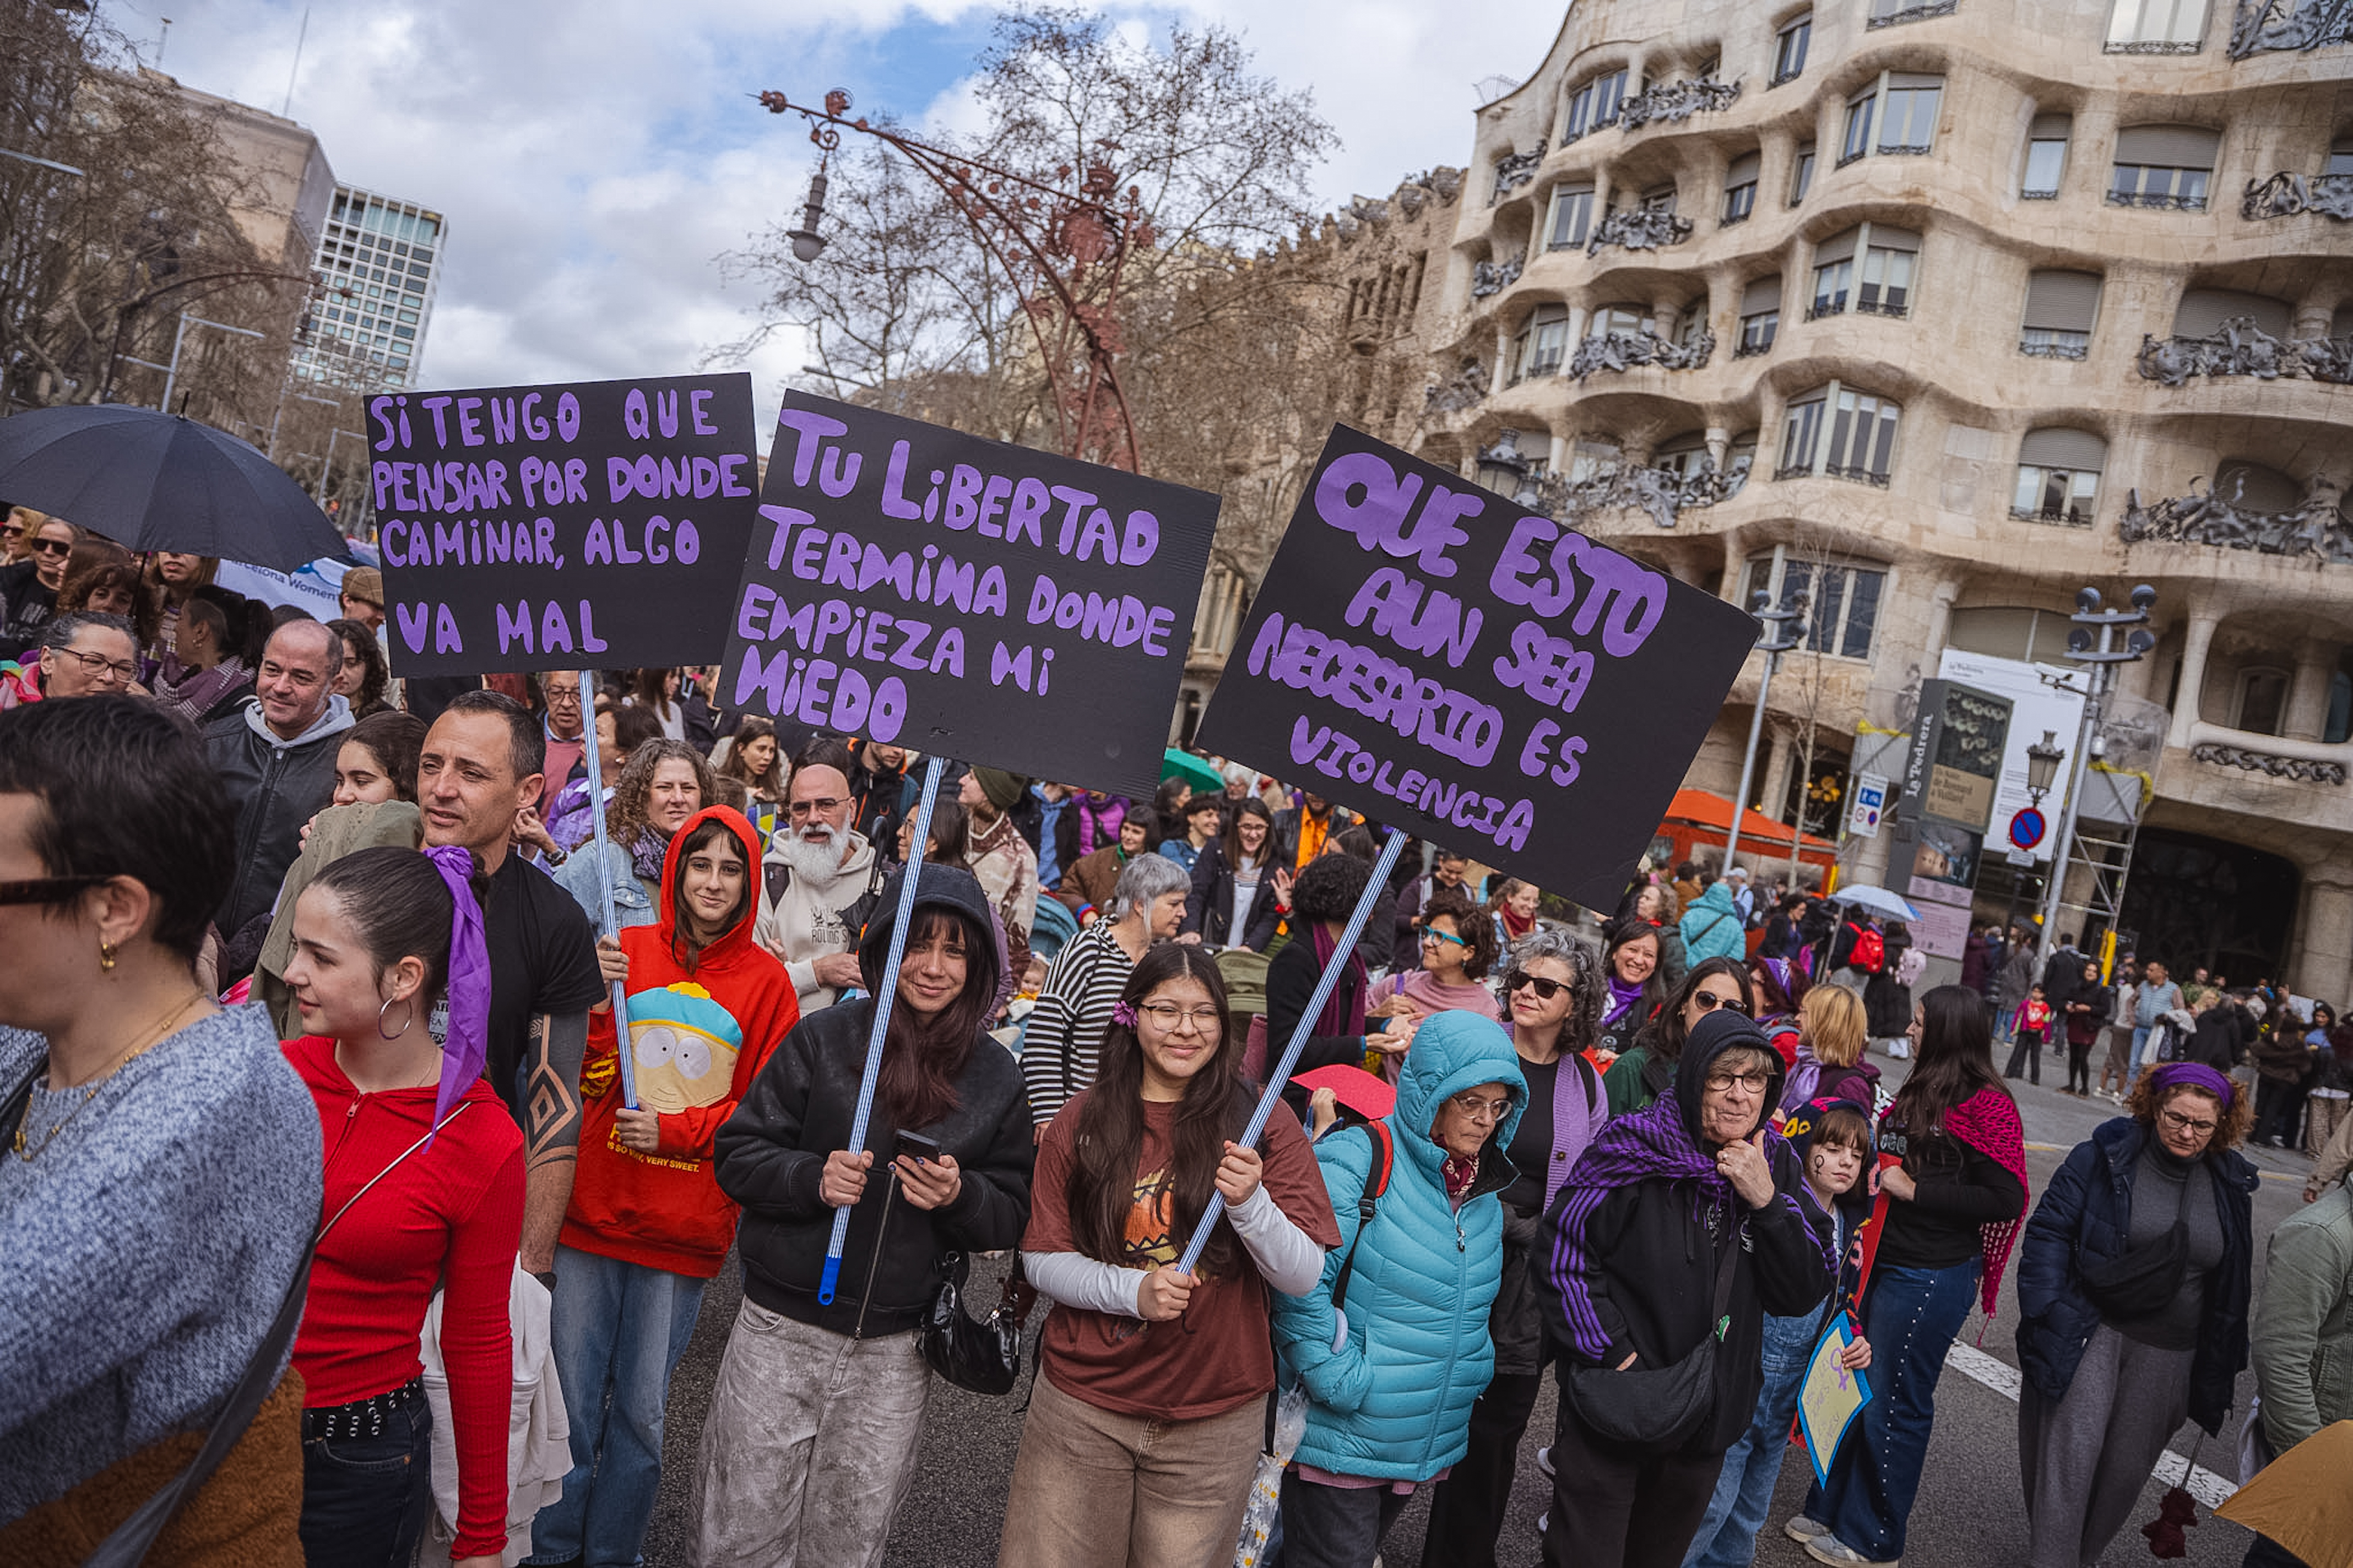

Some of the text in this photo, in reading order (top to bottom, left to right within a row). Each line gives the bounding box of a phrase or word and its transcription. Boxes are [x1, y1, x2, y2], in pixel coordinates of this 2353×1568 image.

[421, 391, 581, 449] TENGO
[624, 388, 719, 440] QUE
[372, 454, 752, 514] PENSAR POR DONDE
[584, 515, 700, 566] ALGO
[1314, 452, 1668, 658] QUE ESTO
[289, 578, 335, 601] Women
[1026, 574, 1176, 657] DONDE
[396, 599, 608, 655] VA MAL
[1344, 567, 1595, 713] AUN SEA
[1247, 611, 1588, 787] NECESARIO ES
[1289, 715, 1534, 852] VIOLENCIA
[615, 1144, 628, 1154] SO
[646, 1155, 670, 1167] VERY
[669, 1160, 700, 1172] SWEET.
